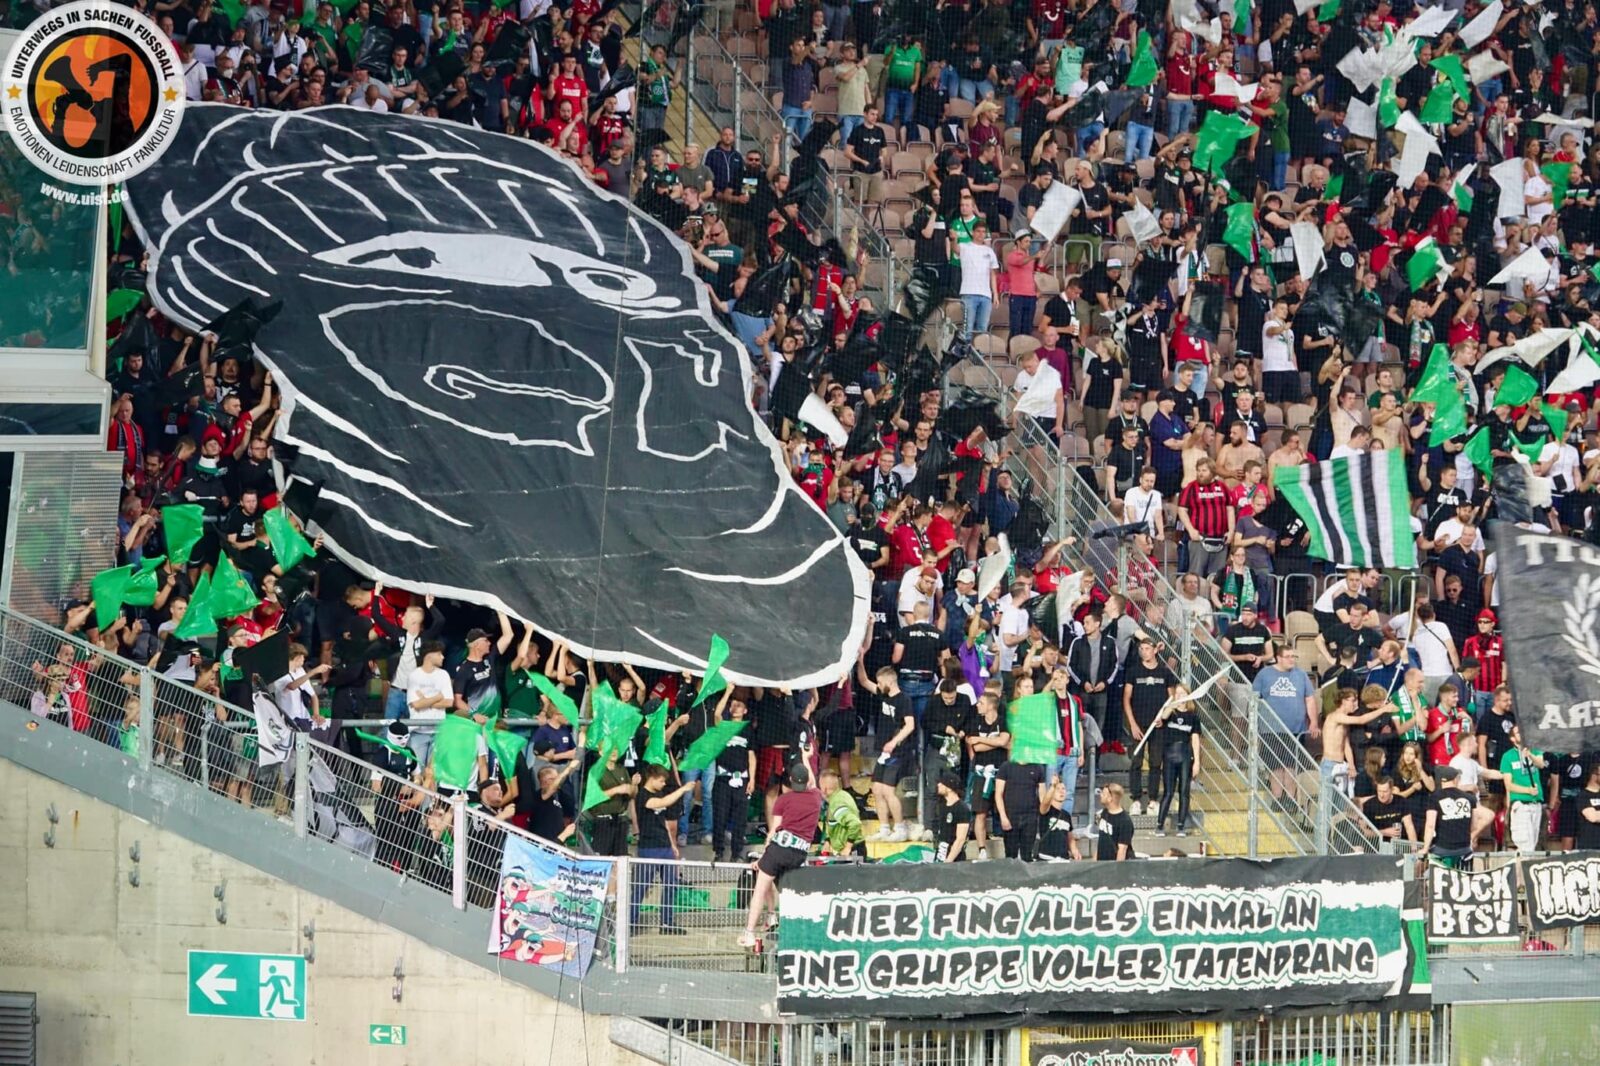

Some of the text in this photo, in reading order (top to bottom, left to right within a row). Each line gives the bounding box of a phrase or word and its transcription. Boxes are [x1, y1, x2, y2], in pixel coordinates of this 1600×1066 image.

[1433, 866, 1512, 902] FUCK
[831, 895, 1318, 939] HIER FING ALLES EINMAL AN
[778, 941, 1375, 990] EINE GRUPPE VOLLER TATENDRANG
